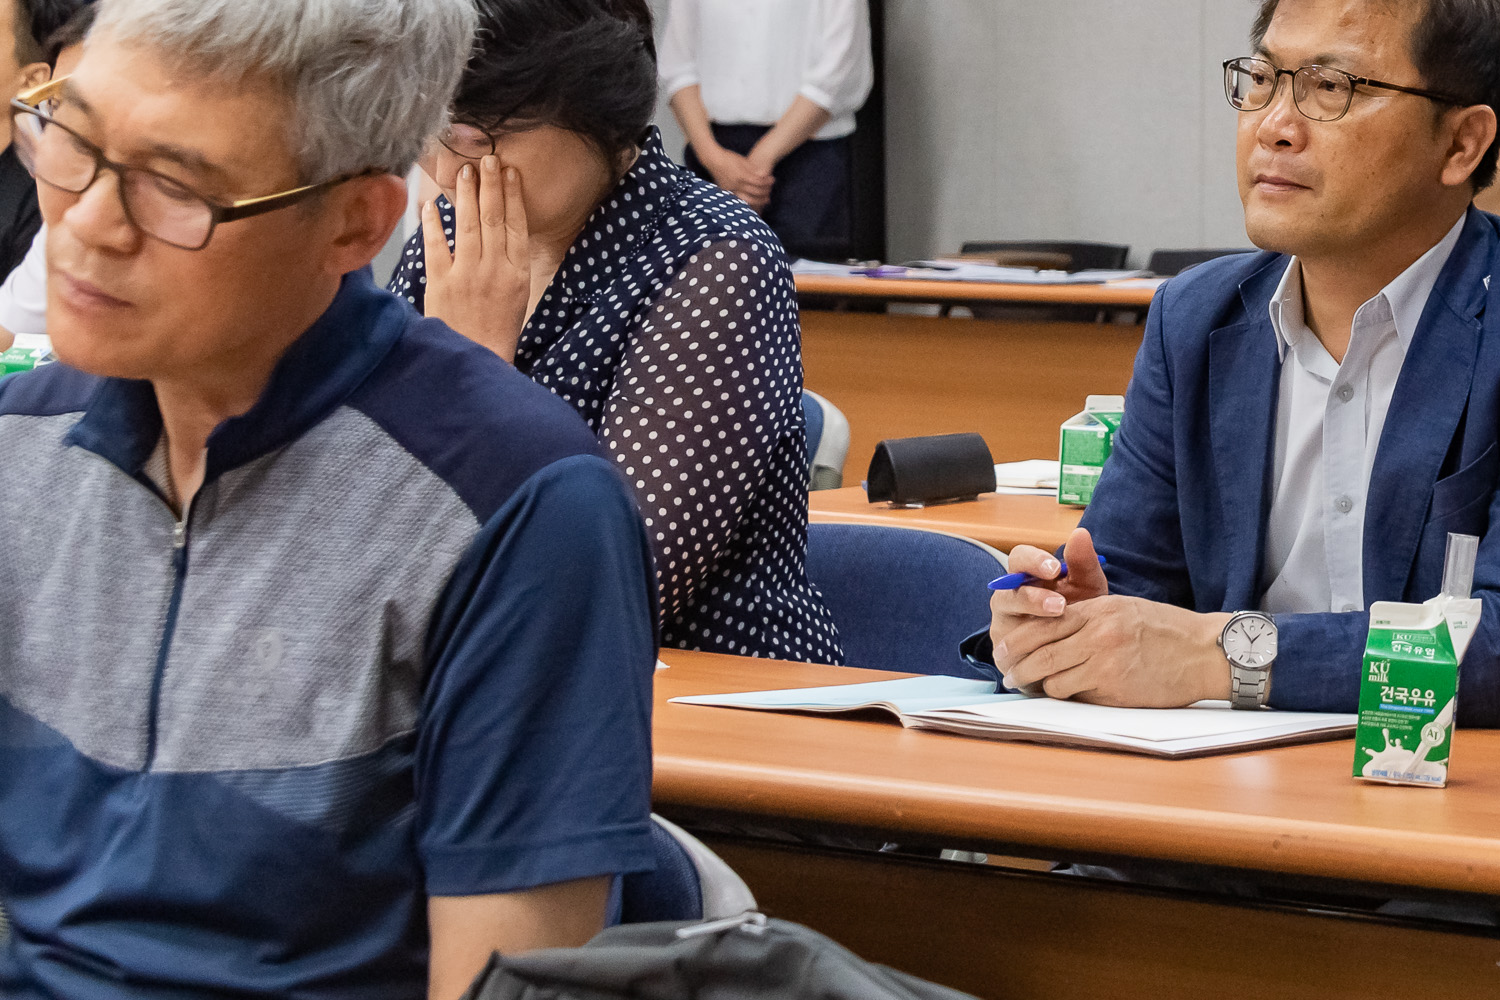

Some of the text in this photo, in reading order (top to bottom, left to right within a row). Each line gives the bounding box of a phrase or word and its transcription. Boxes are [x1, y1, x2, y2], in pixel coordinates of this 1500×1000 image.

[1369, 660, 1390, 674] KU
[1368, 673, 1389, 683] milk
[1380, 686, 1437, 707] 건국우유
